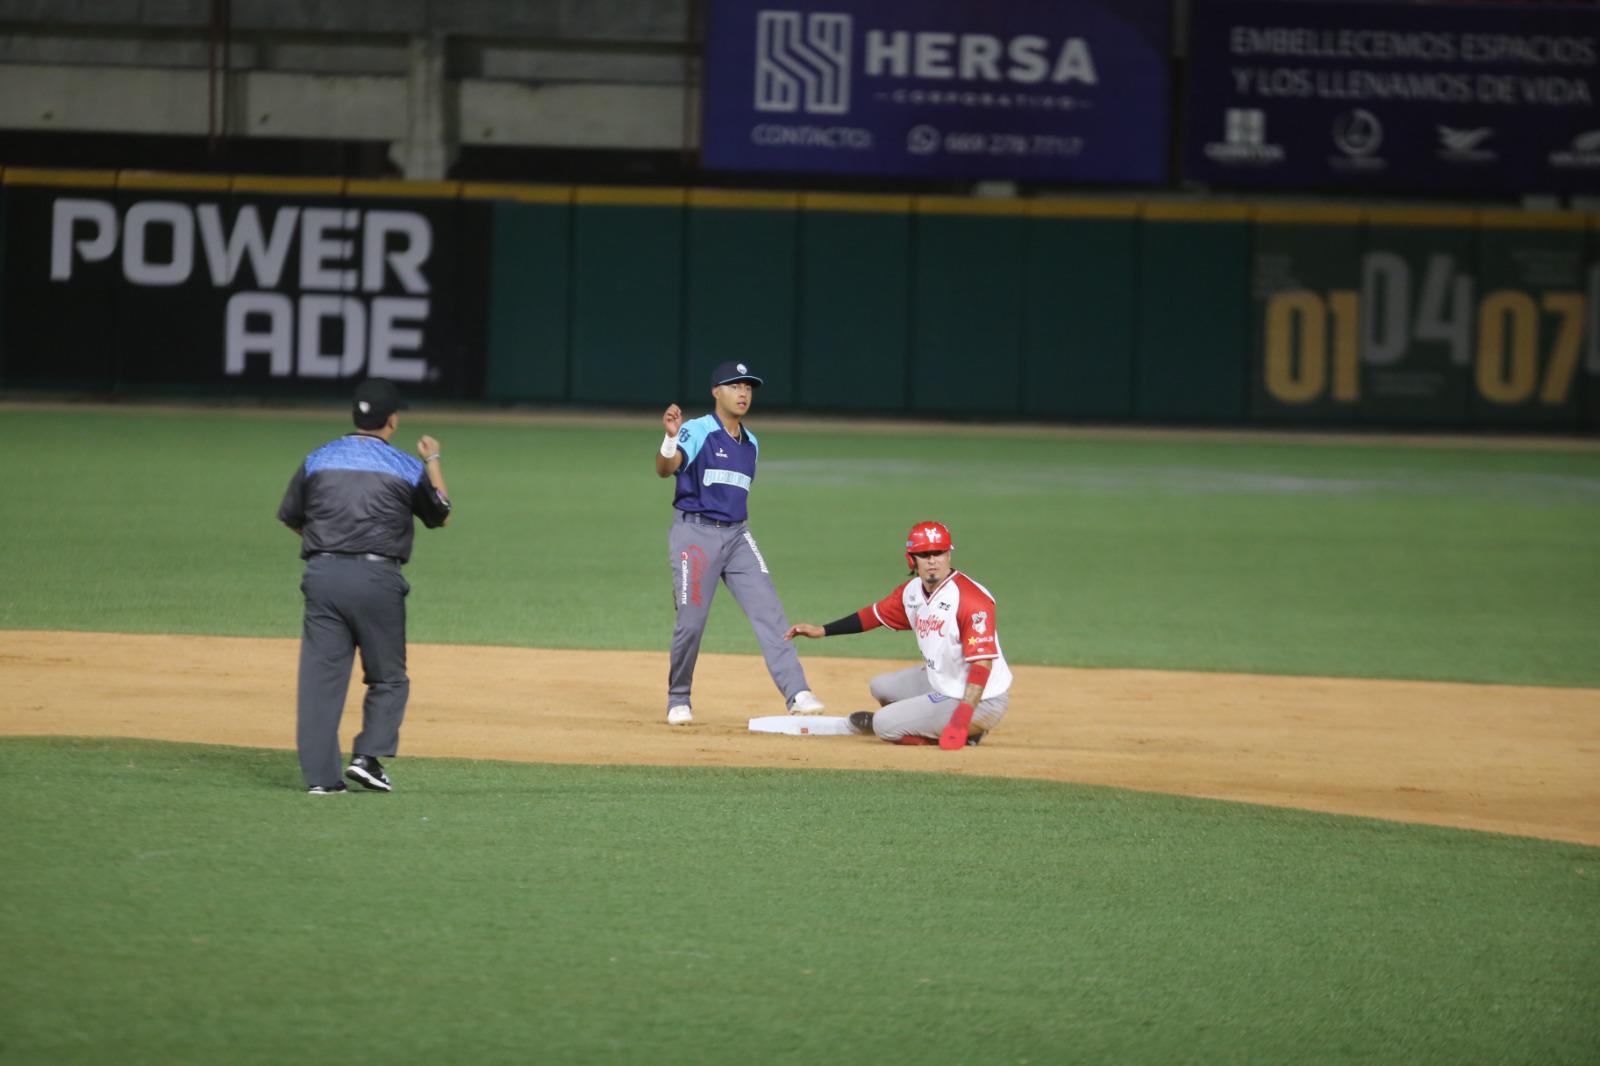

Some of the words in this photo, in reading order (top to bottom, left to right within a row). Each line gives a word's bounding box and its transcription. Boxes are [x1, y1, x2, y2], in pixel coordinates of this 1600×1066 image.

[865, 30, 1097, 84] HERSA
[1230, 26, 1456, 61] EMBELLECEMOS
[1460, 33, 1598, 65] ESPACIOS
[1231, 67, 1252, 95] Y
[1256, 67, 1312, 97] LOS
[1316, 69, 1471, 102] LLENAMOS
[1476, 75, 1517, 103] DE
[1520, 76, 1592, 107] VIDA
[51, 198, 432, 294] POWER
[224, 292, 430, 381] ADE
[1265, 288, 1360, 403] 01
[1476, 289, 1586, 403] 07
